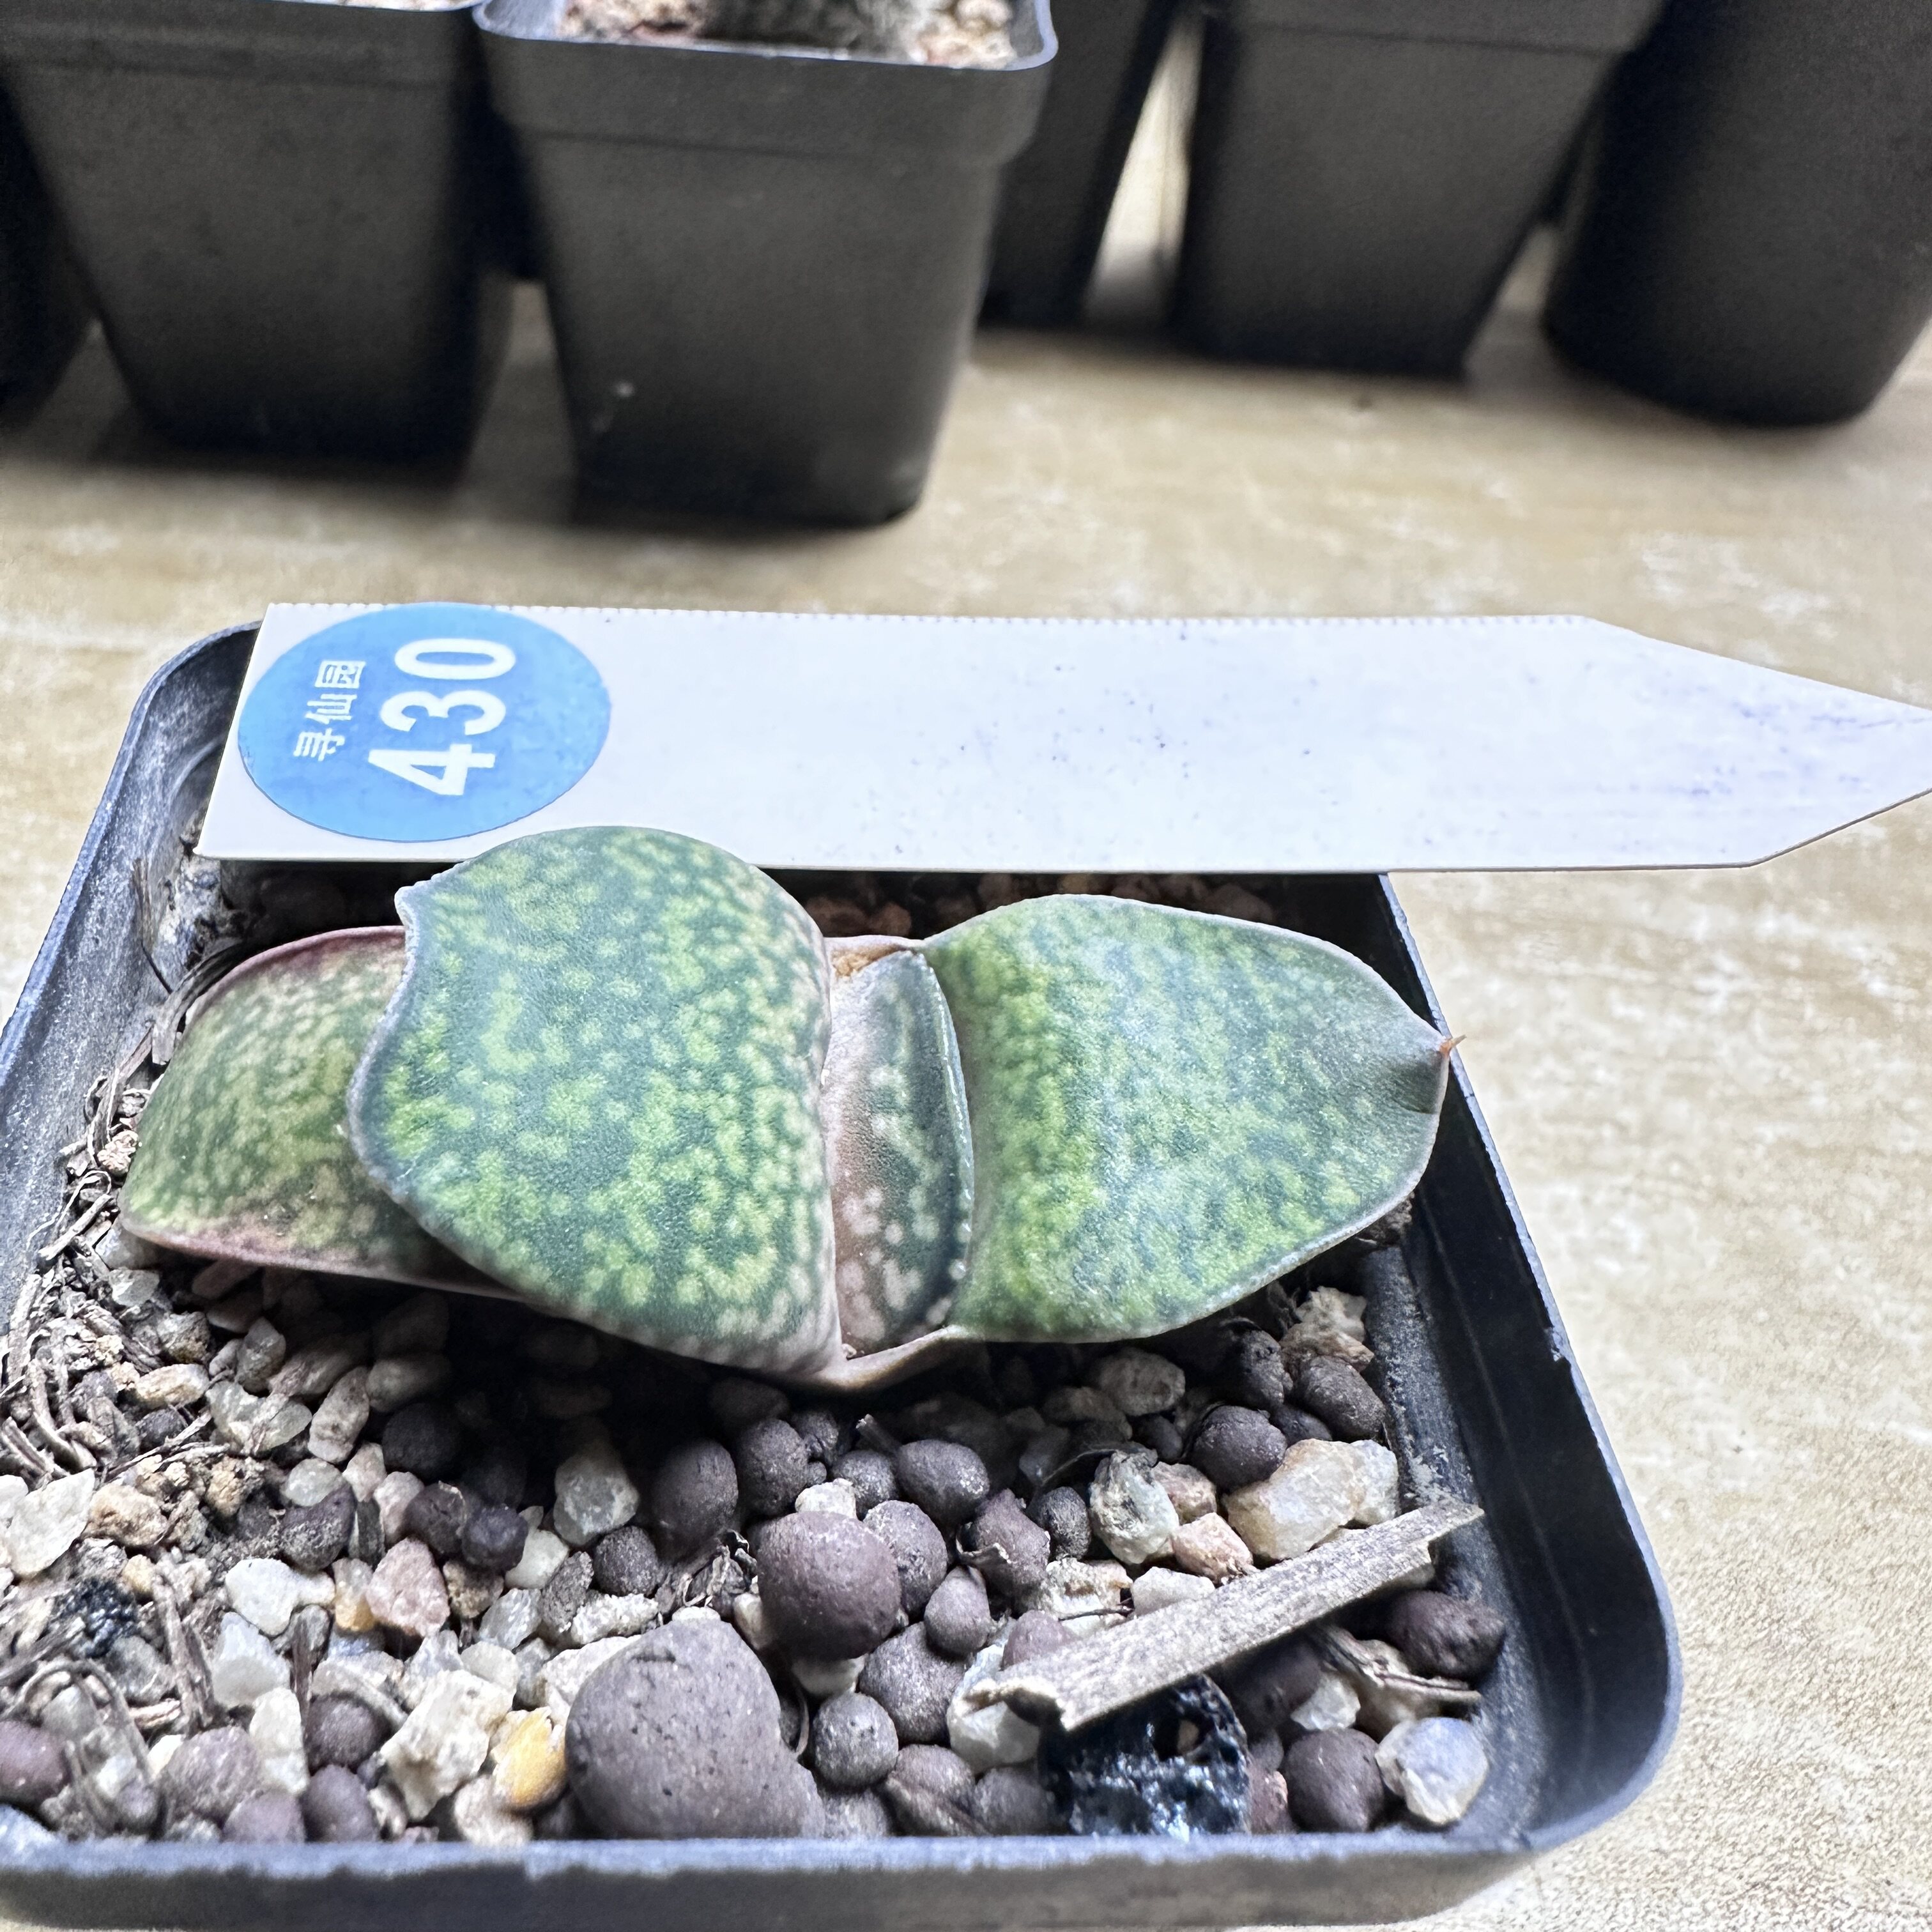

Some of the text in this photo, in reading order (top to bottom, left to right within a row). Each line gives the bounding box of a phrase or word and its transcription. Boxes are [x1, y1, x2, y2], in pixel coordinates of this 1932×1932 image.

[293, 660, 366, 761] 寻仙园
[367, 638, 517, 796] 430
